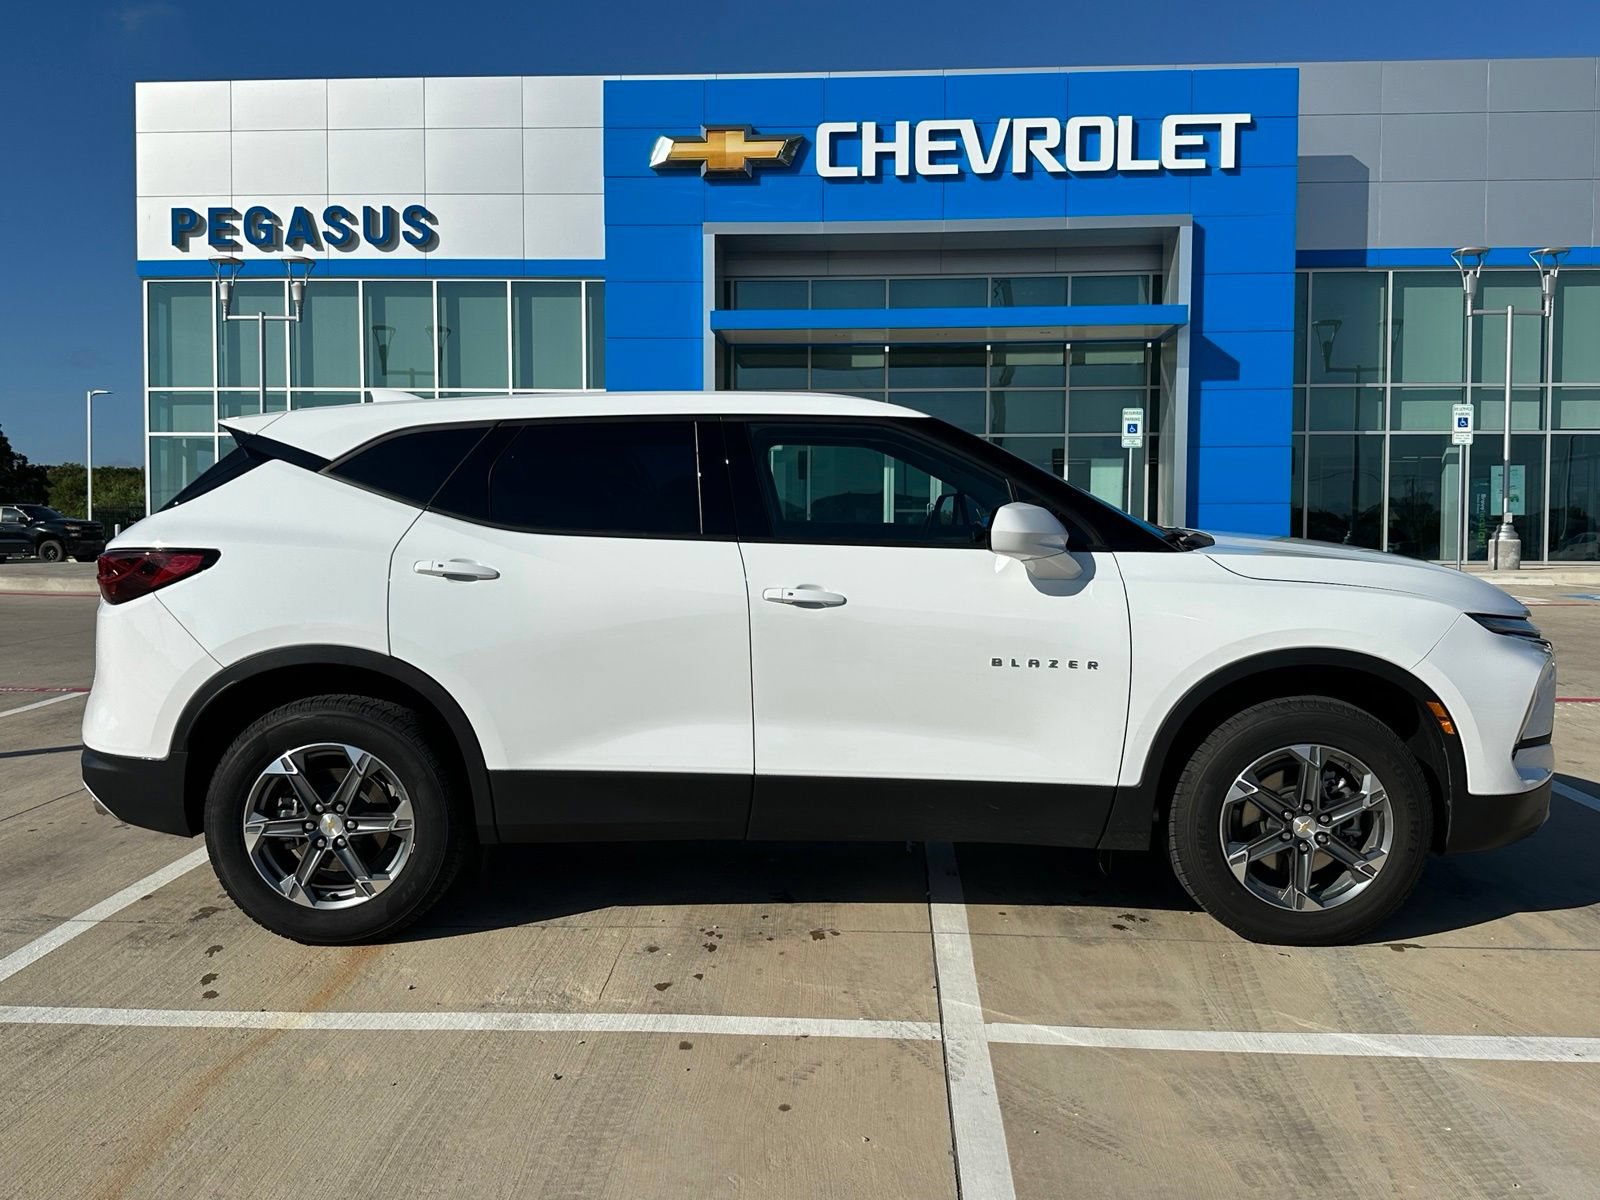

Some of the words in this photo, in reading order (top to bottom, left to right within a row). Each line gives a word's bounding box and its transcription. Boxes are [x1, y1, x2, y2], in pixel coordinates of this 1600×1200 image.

[815, 112, 1252, 178] CHEVROLET
[171, 205, 435, 248] PEGASUS
[991, 658, 1099, 670] BLAZER
